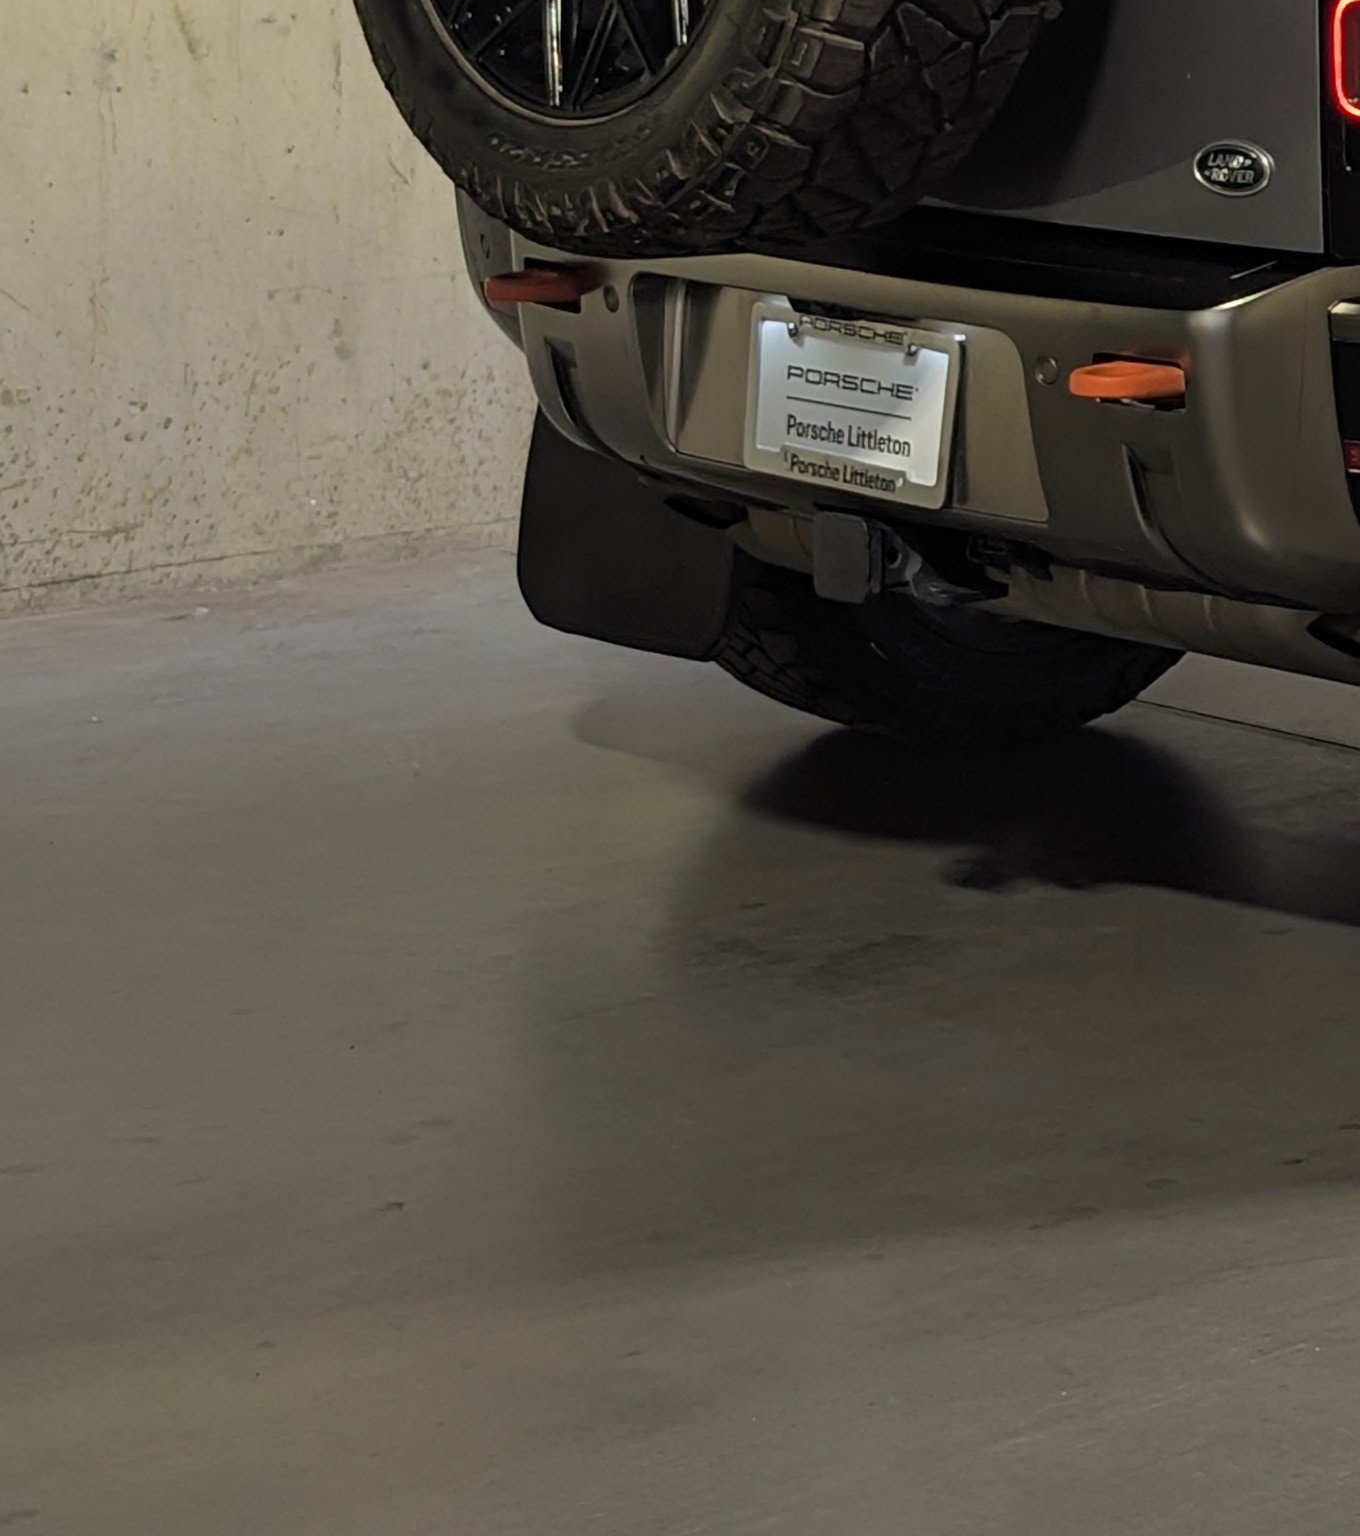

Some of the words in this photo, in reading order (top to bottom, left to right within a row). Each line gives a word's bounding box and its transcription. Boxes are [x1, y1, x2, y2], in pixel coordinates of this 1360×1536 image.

[800, 315, 907, 346] PORSCHE
[786, 364, 914, 401] PORSCHE
[786, 413, 845, 446] Porsche
[847, 424, 912, 458] Littleton
[789, 452, 841, 481] Porsche
[842, 463, 897, 493] Littleton
